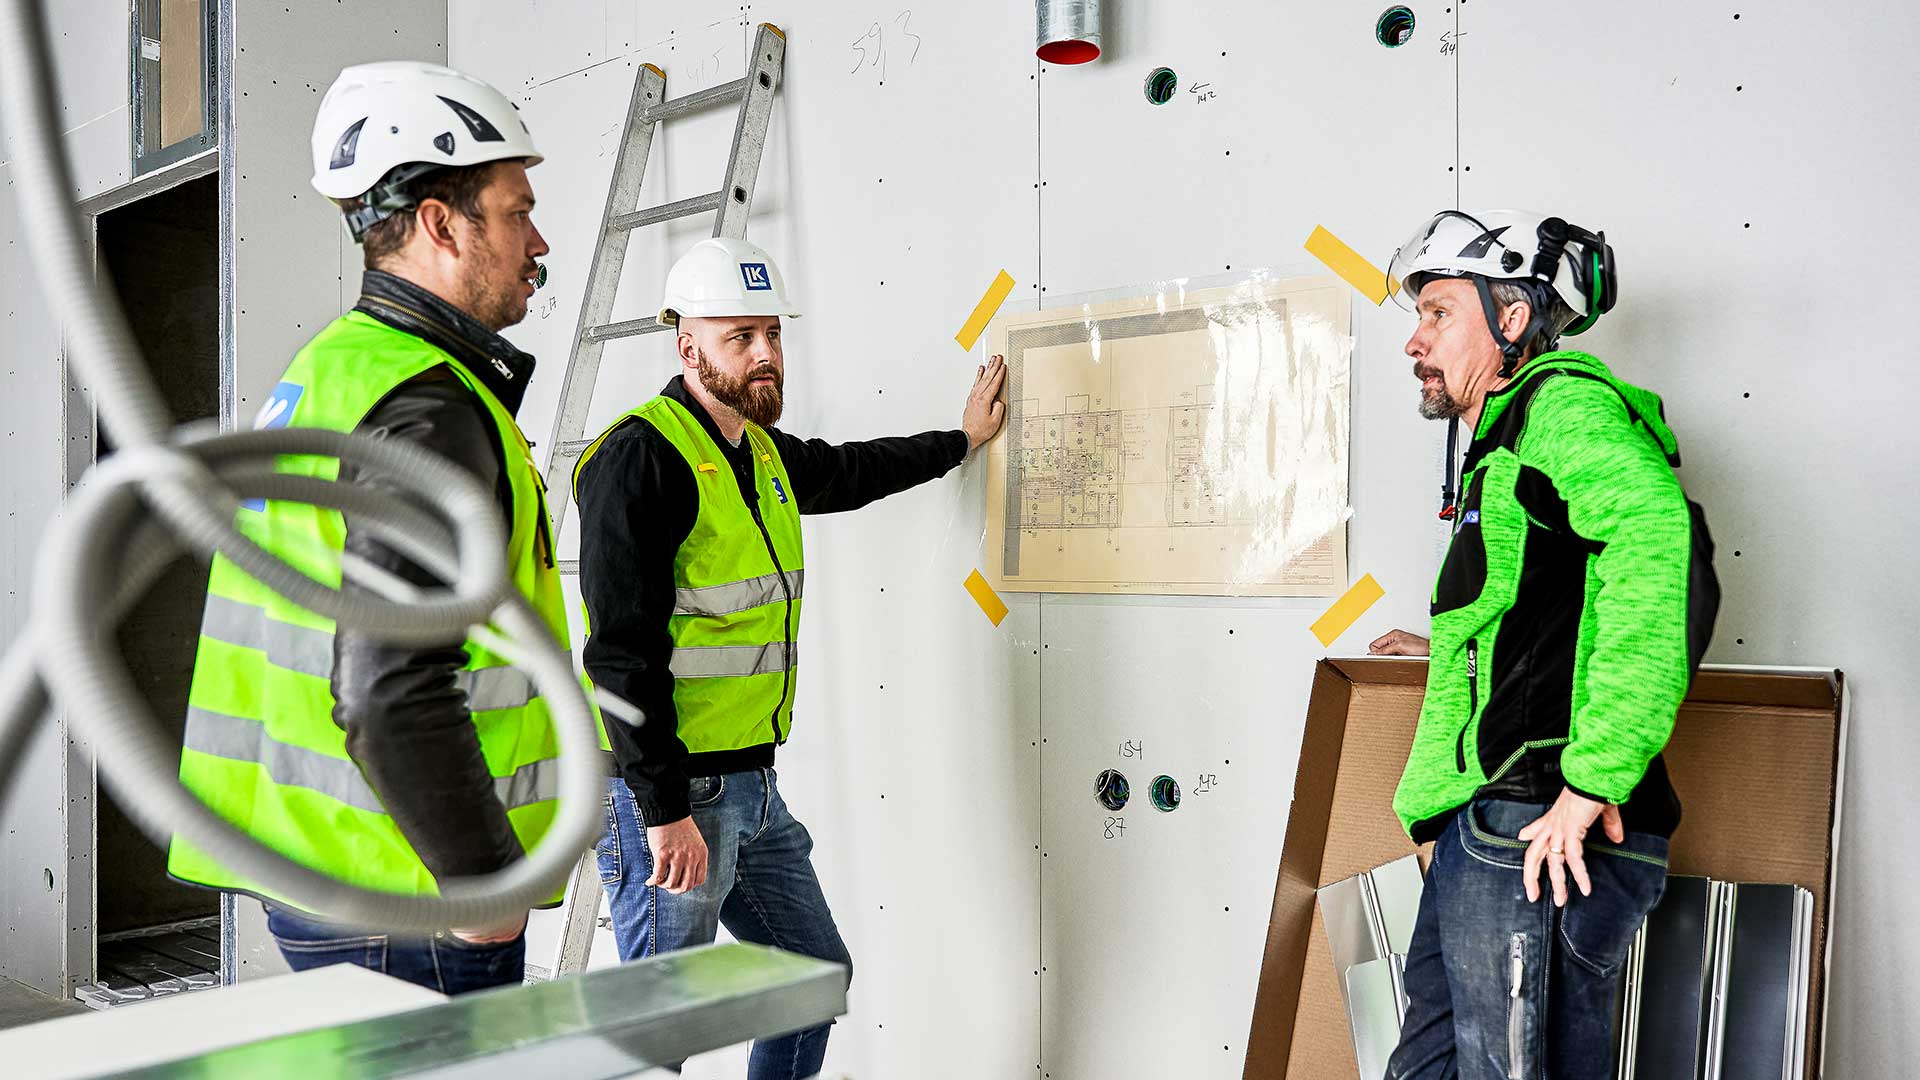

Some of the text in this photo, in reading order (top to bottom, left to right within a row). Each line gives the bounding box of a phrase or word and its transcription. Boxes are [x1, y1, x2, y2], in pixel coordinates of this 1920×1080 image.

[743, 265, 768, 288] LK
[1118, 739, 1143, 760] 154
[1103, 816, 1127, 840] 87
